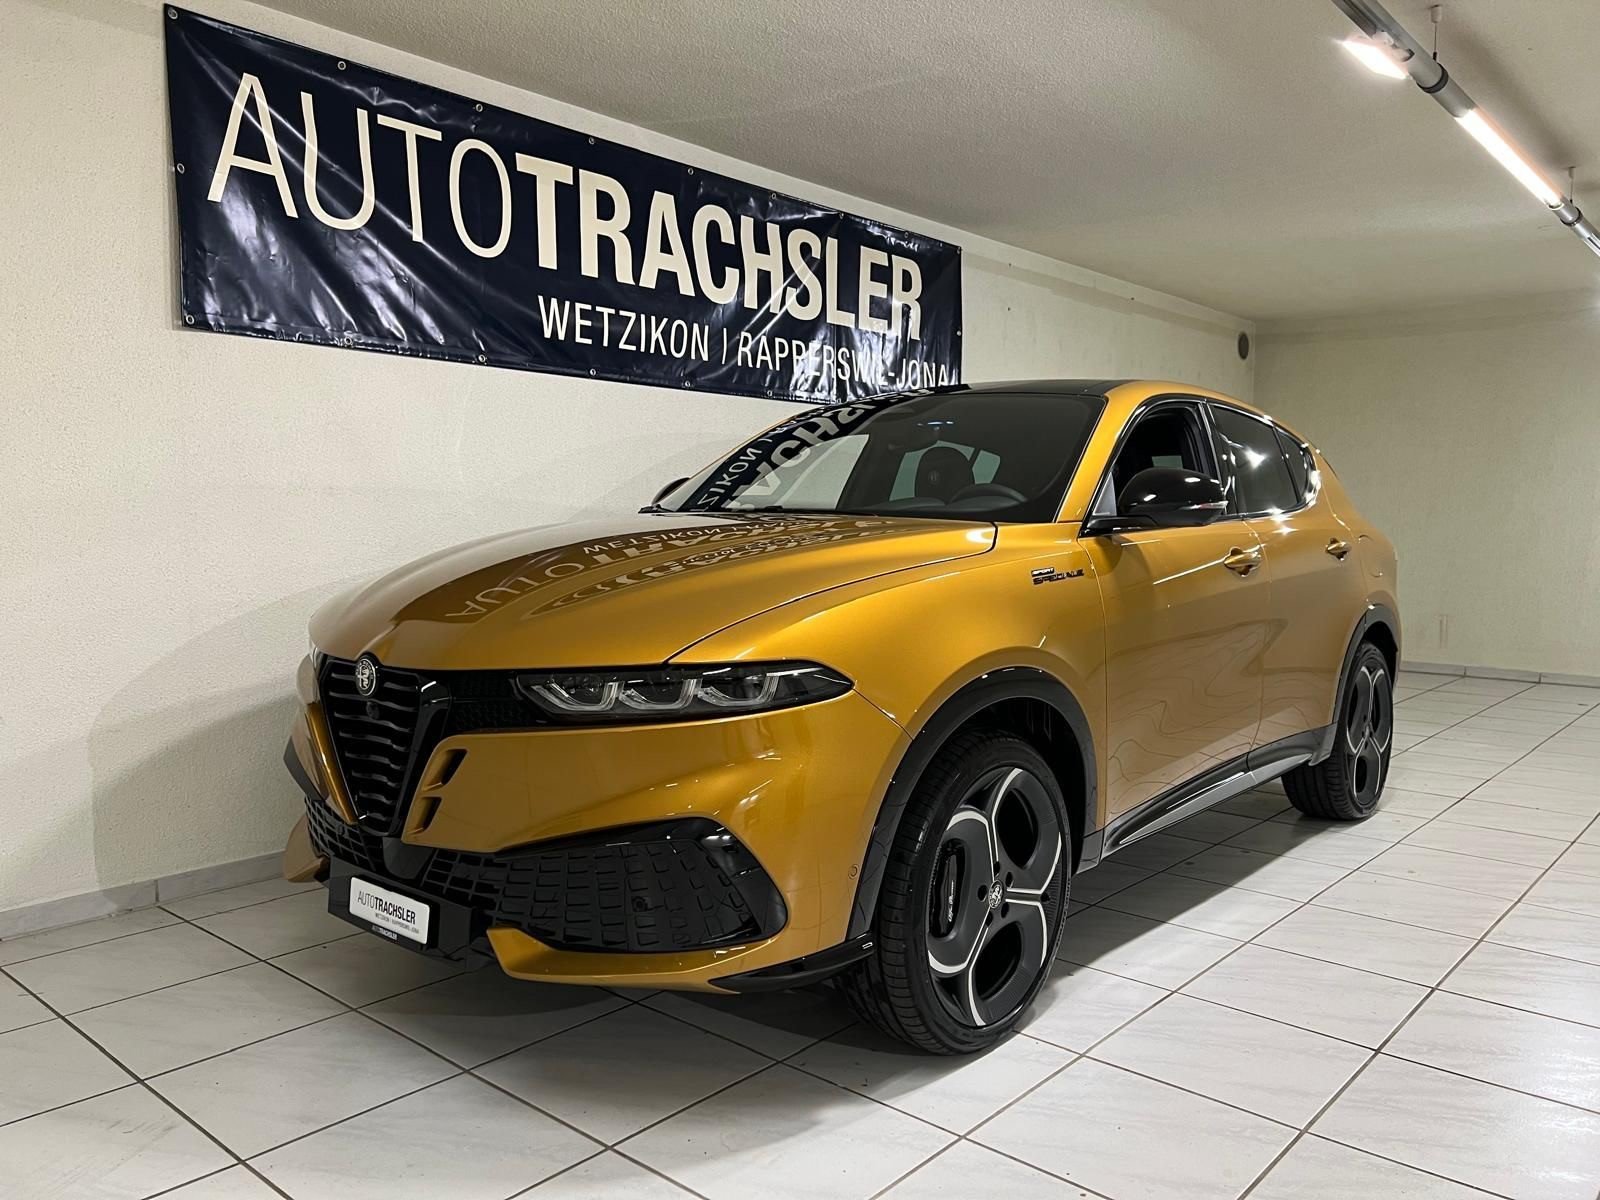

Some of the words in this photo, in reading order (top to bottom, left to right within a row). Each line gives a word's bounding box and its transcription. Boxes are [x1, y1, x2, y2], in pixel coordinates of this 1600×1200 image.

[207, 72, 923, 341] AUTOTRACHSLER
[538, 295, 710, 362] WETZIKON
[357, 890, 416, 925] AUTOTRACHSLER
